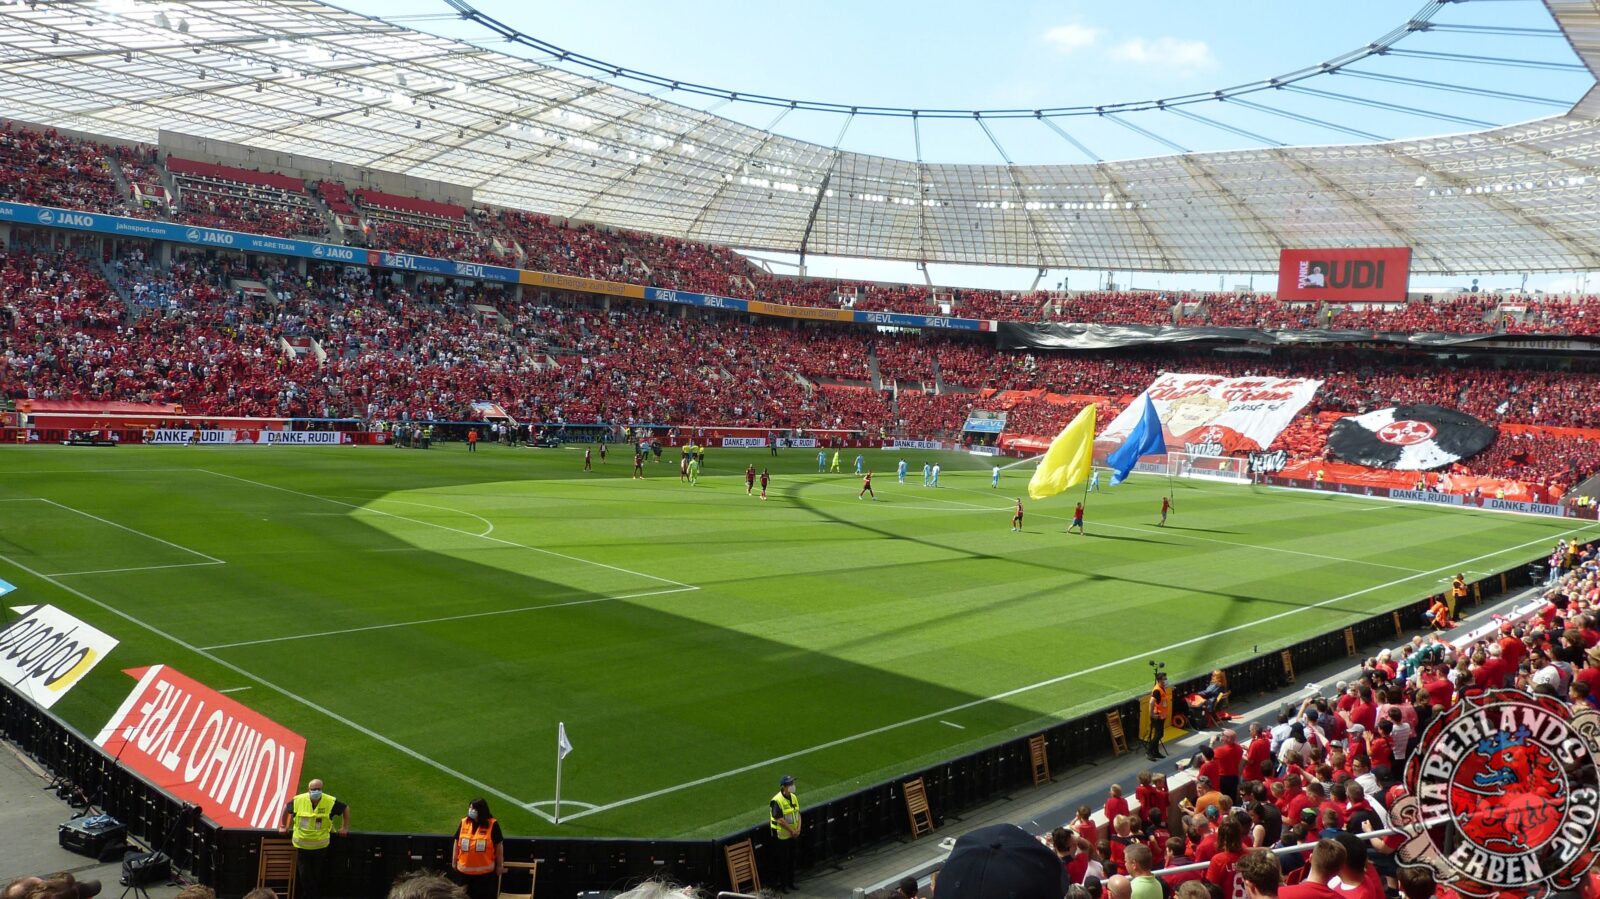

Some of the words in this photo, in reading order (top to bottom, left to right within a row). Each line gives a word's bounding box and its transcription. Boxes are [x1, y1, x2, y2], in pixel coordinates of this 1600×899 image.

[57, 213, 94, 227] JAKO
[202, 231, 234, 244] JAKO
[278, 243, 295, 251] TEAM
[326, 247, 353, 260] JAKO
[395, 255, 417, 269] EVL
[465, 265, 486, 278] EVL
[1308, 260, 1385, 289] RUDI
[663, 291, 678, 302] EVL
[710, 297, 725, 308] EVL
[875, 314, 894, 324] EVL
[934, 318, 952, 328] EVL
[268, 432, 306, 444] DANKE,
[308, 433, 335, 443] RUDI!
[1393, 489, 1427, 502] DANKE,
[1428, 492, 1454, 504] RUDI!
[1491, 499, 1528, 513] DANKE,
[1530, 503, 1559, 515] RUDI!
[122, 679, 206, 773] TYRE
[183, 708, 295, 829] KUMHO
